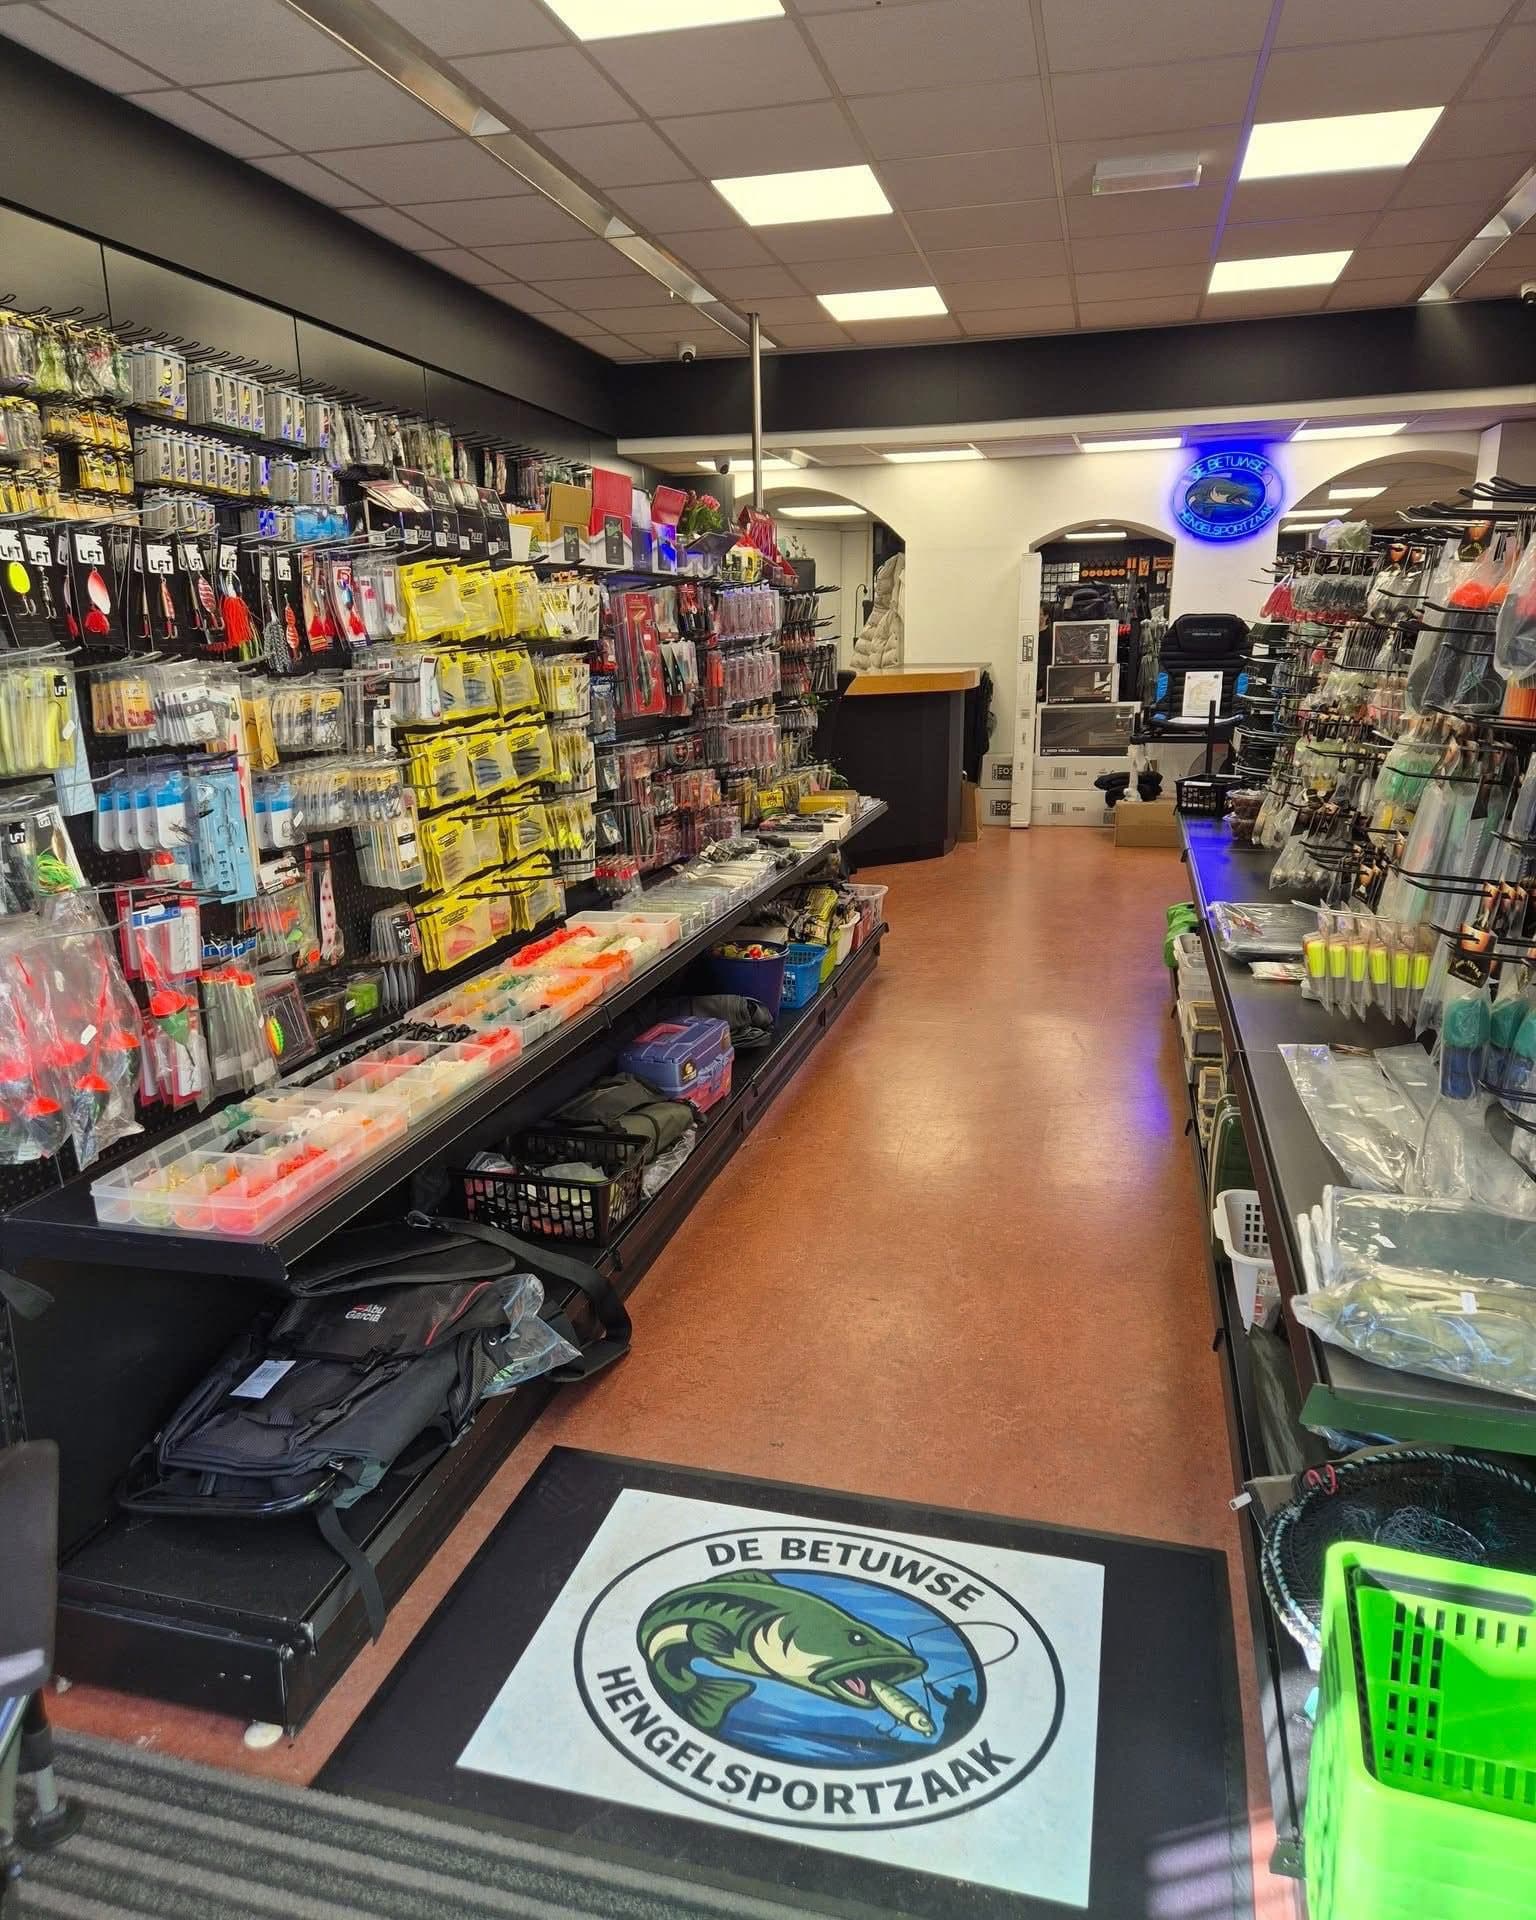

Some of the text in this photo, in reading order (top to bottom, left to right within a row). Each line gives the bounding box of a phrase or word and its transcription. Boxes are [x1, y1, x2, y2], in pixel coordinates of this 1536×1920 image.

[1191, 455, 1266, 479] DE BETUWSE
[30, 551, 49, 563] LFT
[80, 549, 102, 562] LFT
[150, 560, 172, 571] LFT
[9, 832, 25, 844] LFT
[366, 1304, 387, 1314] Abu
[345, 1311, 382, 1322] Garcia
[705, 1537, 987, 1612] DE BETUWSE
[596, 1665, 1016, 1816] HENGELSPORTZAAK
